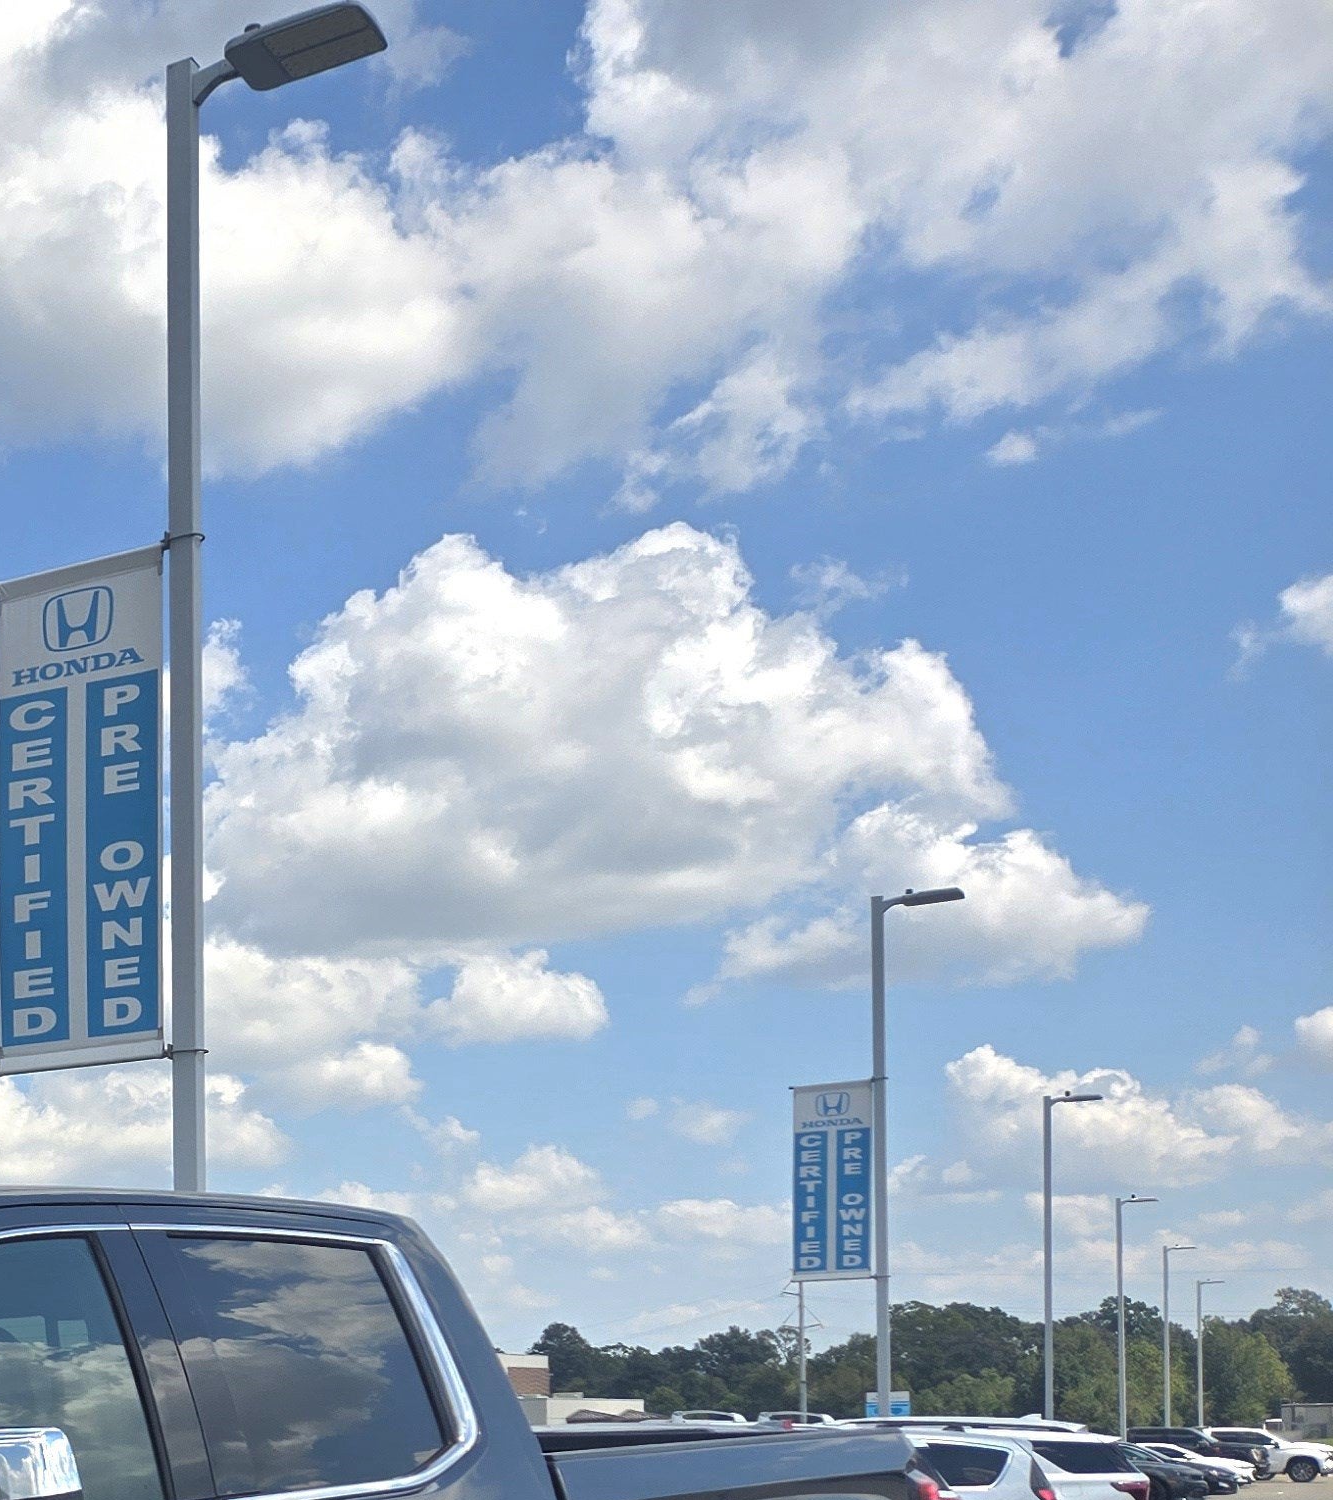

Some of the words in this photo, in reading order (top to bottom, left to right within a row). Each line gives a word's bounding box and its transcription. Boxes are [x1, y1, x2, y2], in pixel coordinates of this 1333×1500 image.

[11, 646, 145, 687] HONDA
[100, 683, 141, 797] PRE
[8, 698, 58, 1039] CERTIFIED
[93, 840, 150, 1029] OWNED
[801, 1117, 863, 1129] HONDA
[842, 1131, 863, 1176] PRE
[799, 1133, 822, 1270] CERTIFIED
[839, 1193, 866, 1268] OWNED
